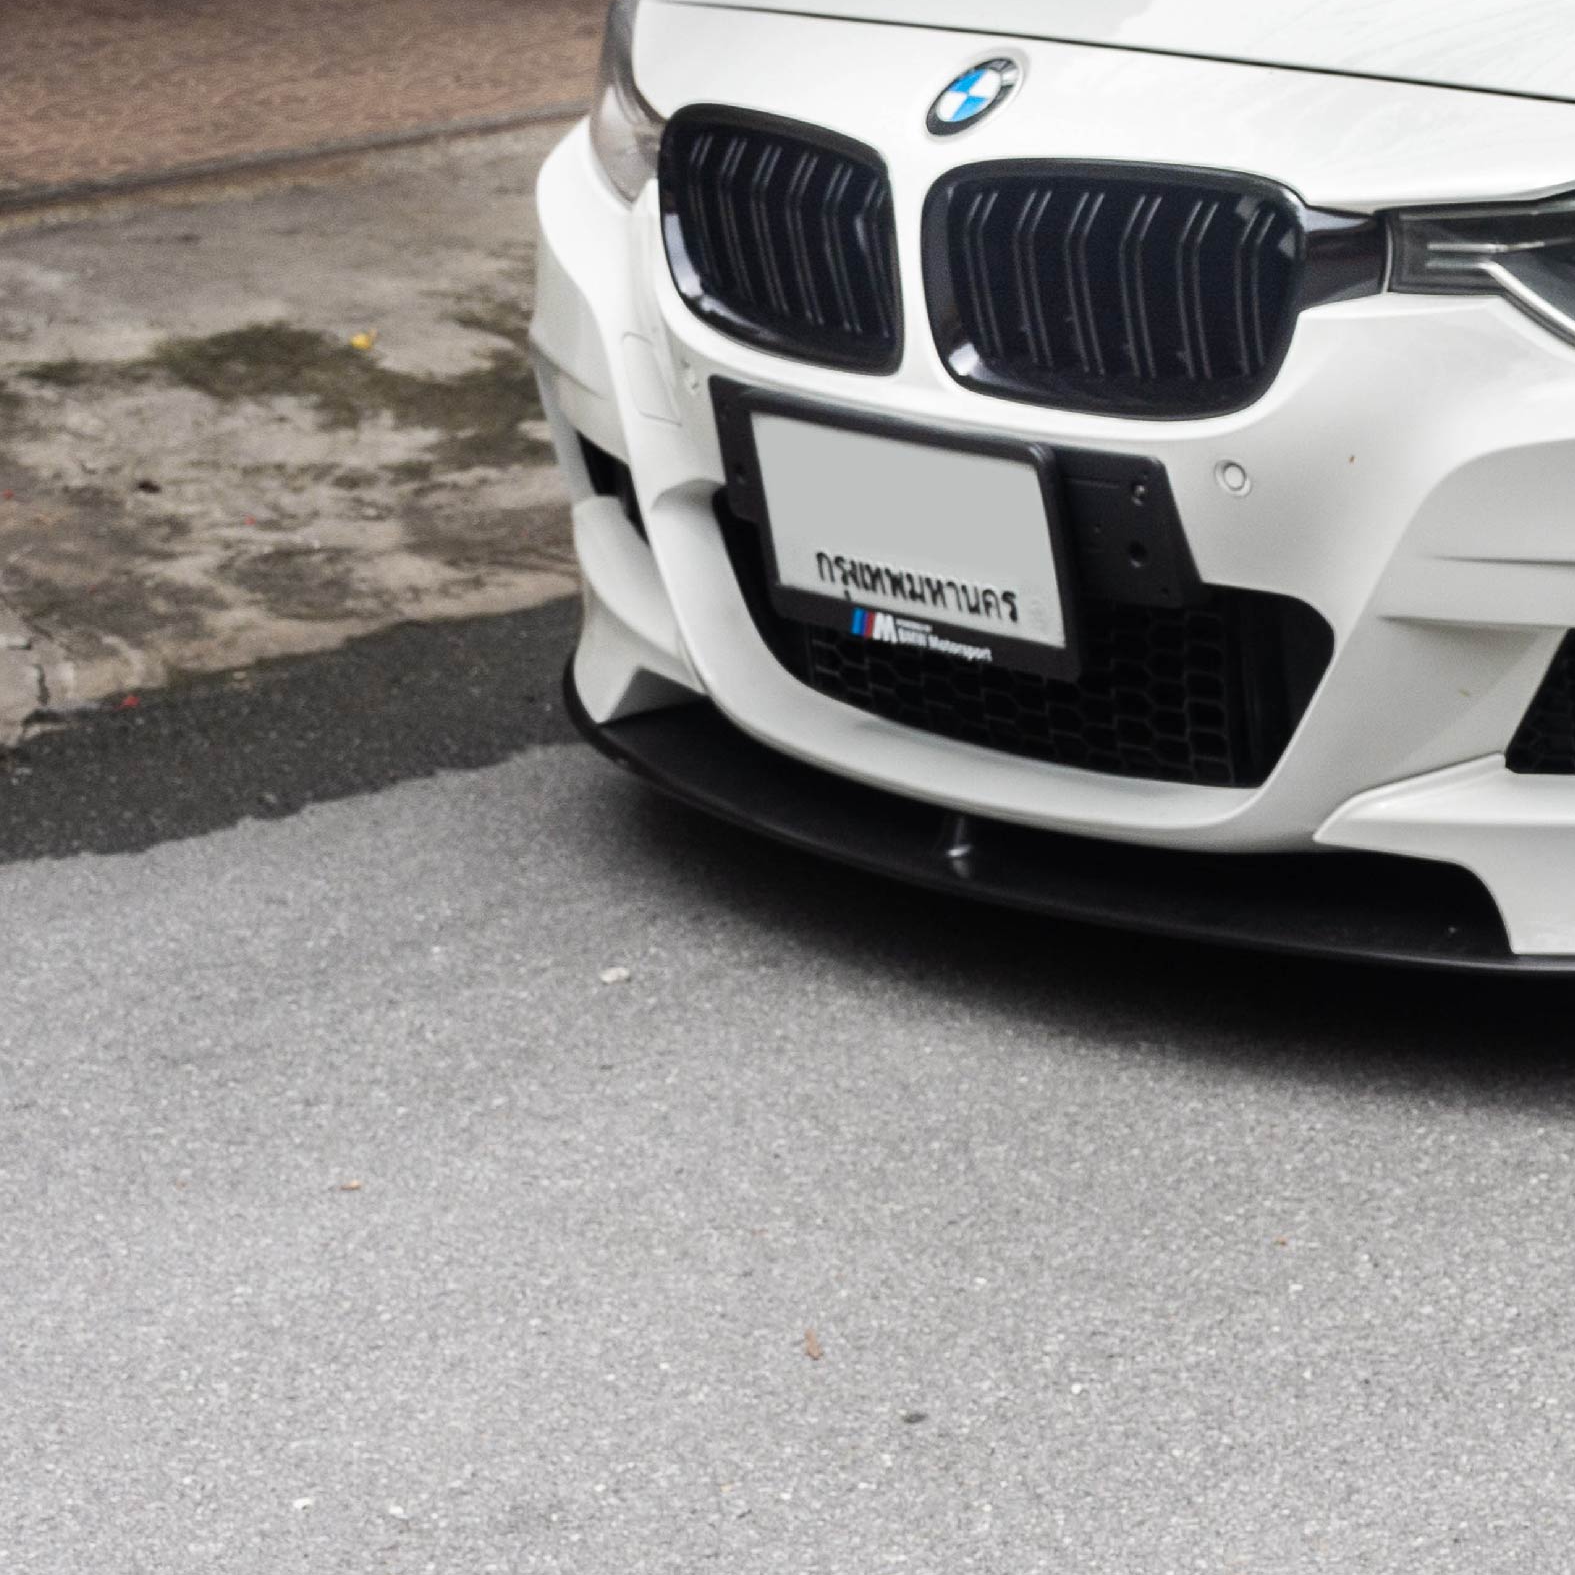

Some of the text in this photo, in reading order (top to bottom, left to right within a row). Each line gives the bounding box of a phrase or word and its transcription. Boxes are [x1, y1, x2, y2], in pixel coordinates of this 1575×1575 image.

[815, 551, 1019, 622] กรุงเทพมหานคร
